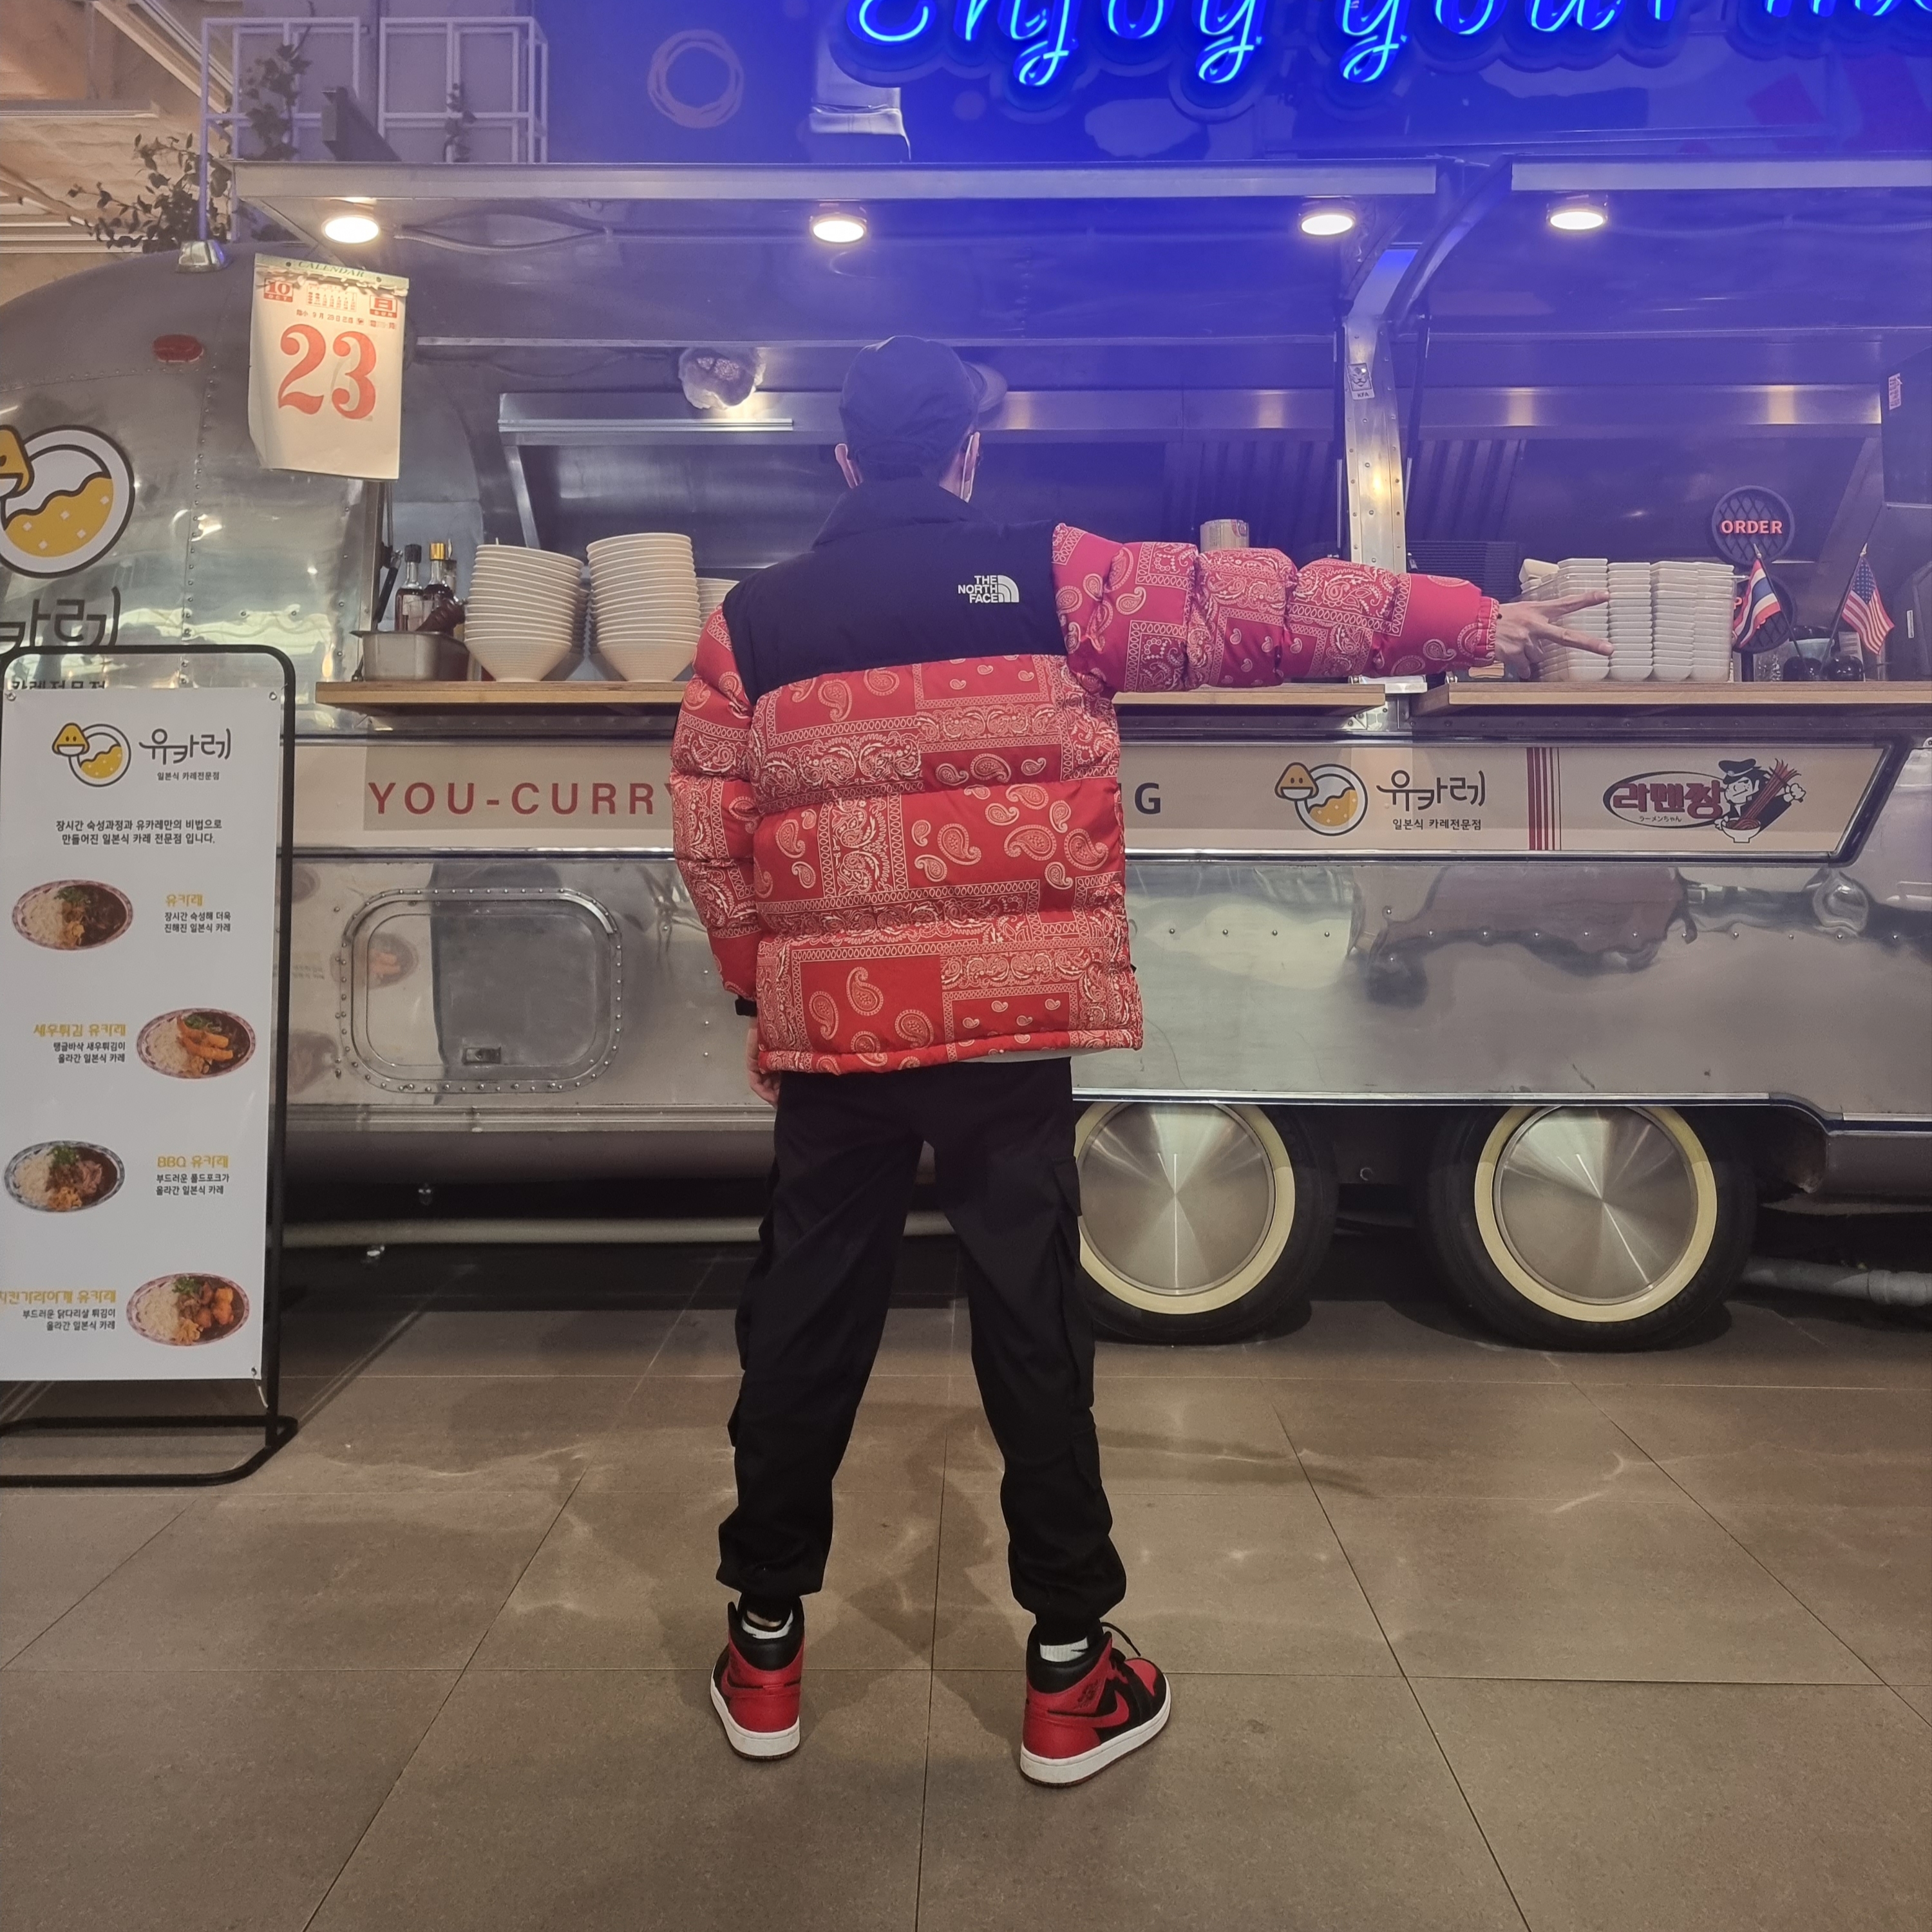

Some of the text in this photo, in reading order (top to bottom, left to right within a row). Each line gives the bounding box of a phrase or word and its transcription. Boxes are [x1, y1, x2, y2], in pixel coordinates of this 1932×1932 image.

[298, 261, 365, 277] CALENDAR
[266, 281, 291, 295] 10
[278, 323, 377, 421] 23
[1721, 520, 1783, 535] ORDER
[974, 575, 998, 585] THE
[958, 584, 998, 594] NORTH
[969, 593, 998, 603] FACE
[139, 728, 231, 765] 유카레
[157, 772, 219, 781] 일본식 카레전문점
[1376, 770, 1485, 811] 유카레
[1613, 781, 1725, 819] 라멘짱
[56, 819, 222, 831] 장시간 숙성과정과 유카레만의 비법으로
[1393, 819, 1481, 830] 일본식 카레전문점
[62, 834, 98, 845] 만들어진
[102, 834, 129, 844] 일본식
[133, 833, 151, 844] 카레
[155, 833, 182, 844] 전문점
[166, 894, 203, 907] 유카레
[165, 912, 231, 922] 장시간 숙성해 더욱
[165, 923, 231, 933] 진해진 일본식 카레
[86, 1042, 125, 1052] 새우튀김이
[58, 1054, 125, 1063] 올라간 일본식 카레
[157, 1155, 229, 1168] BBQ 유카레
[156, 1174, 187, 1183] 부드러운
[156, 1186, 223, 1195] 올라간 일본식 카레
[23, 1309, 54, 1319] 부드러운
[73, 1321, 96, 1331] 일본식
[100, 1321, 115, 1329] 카레
